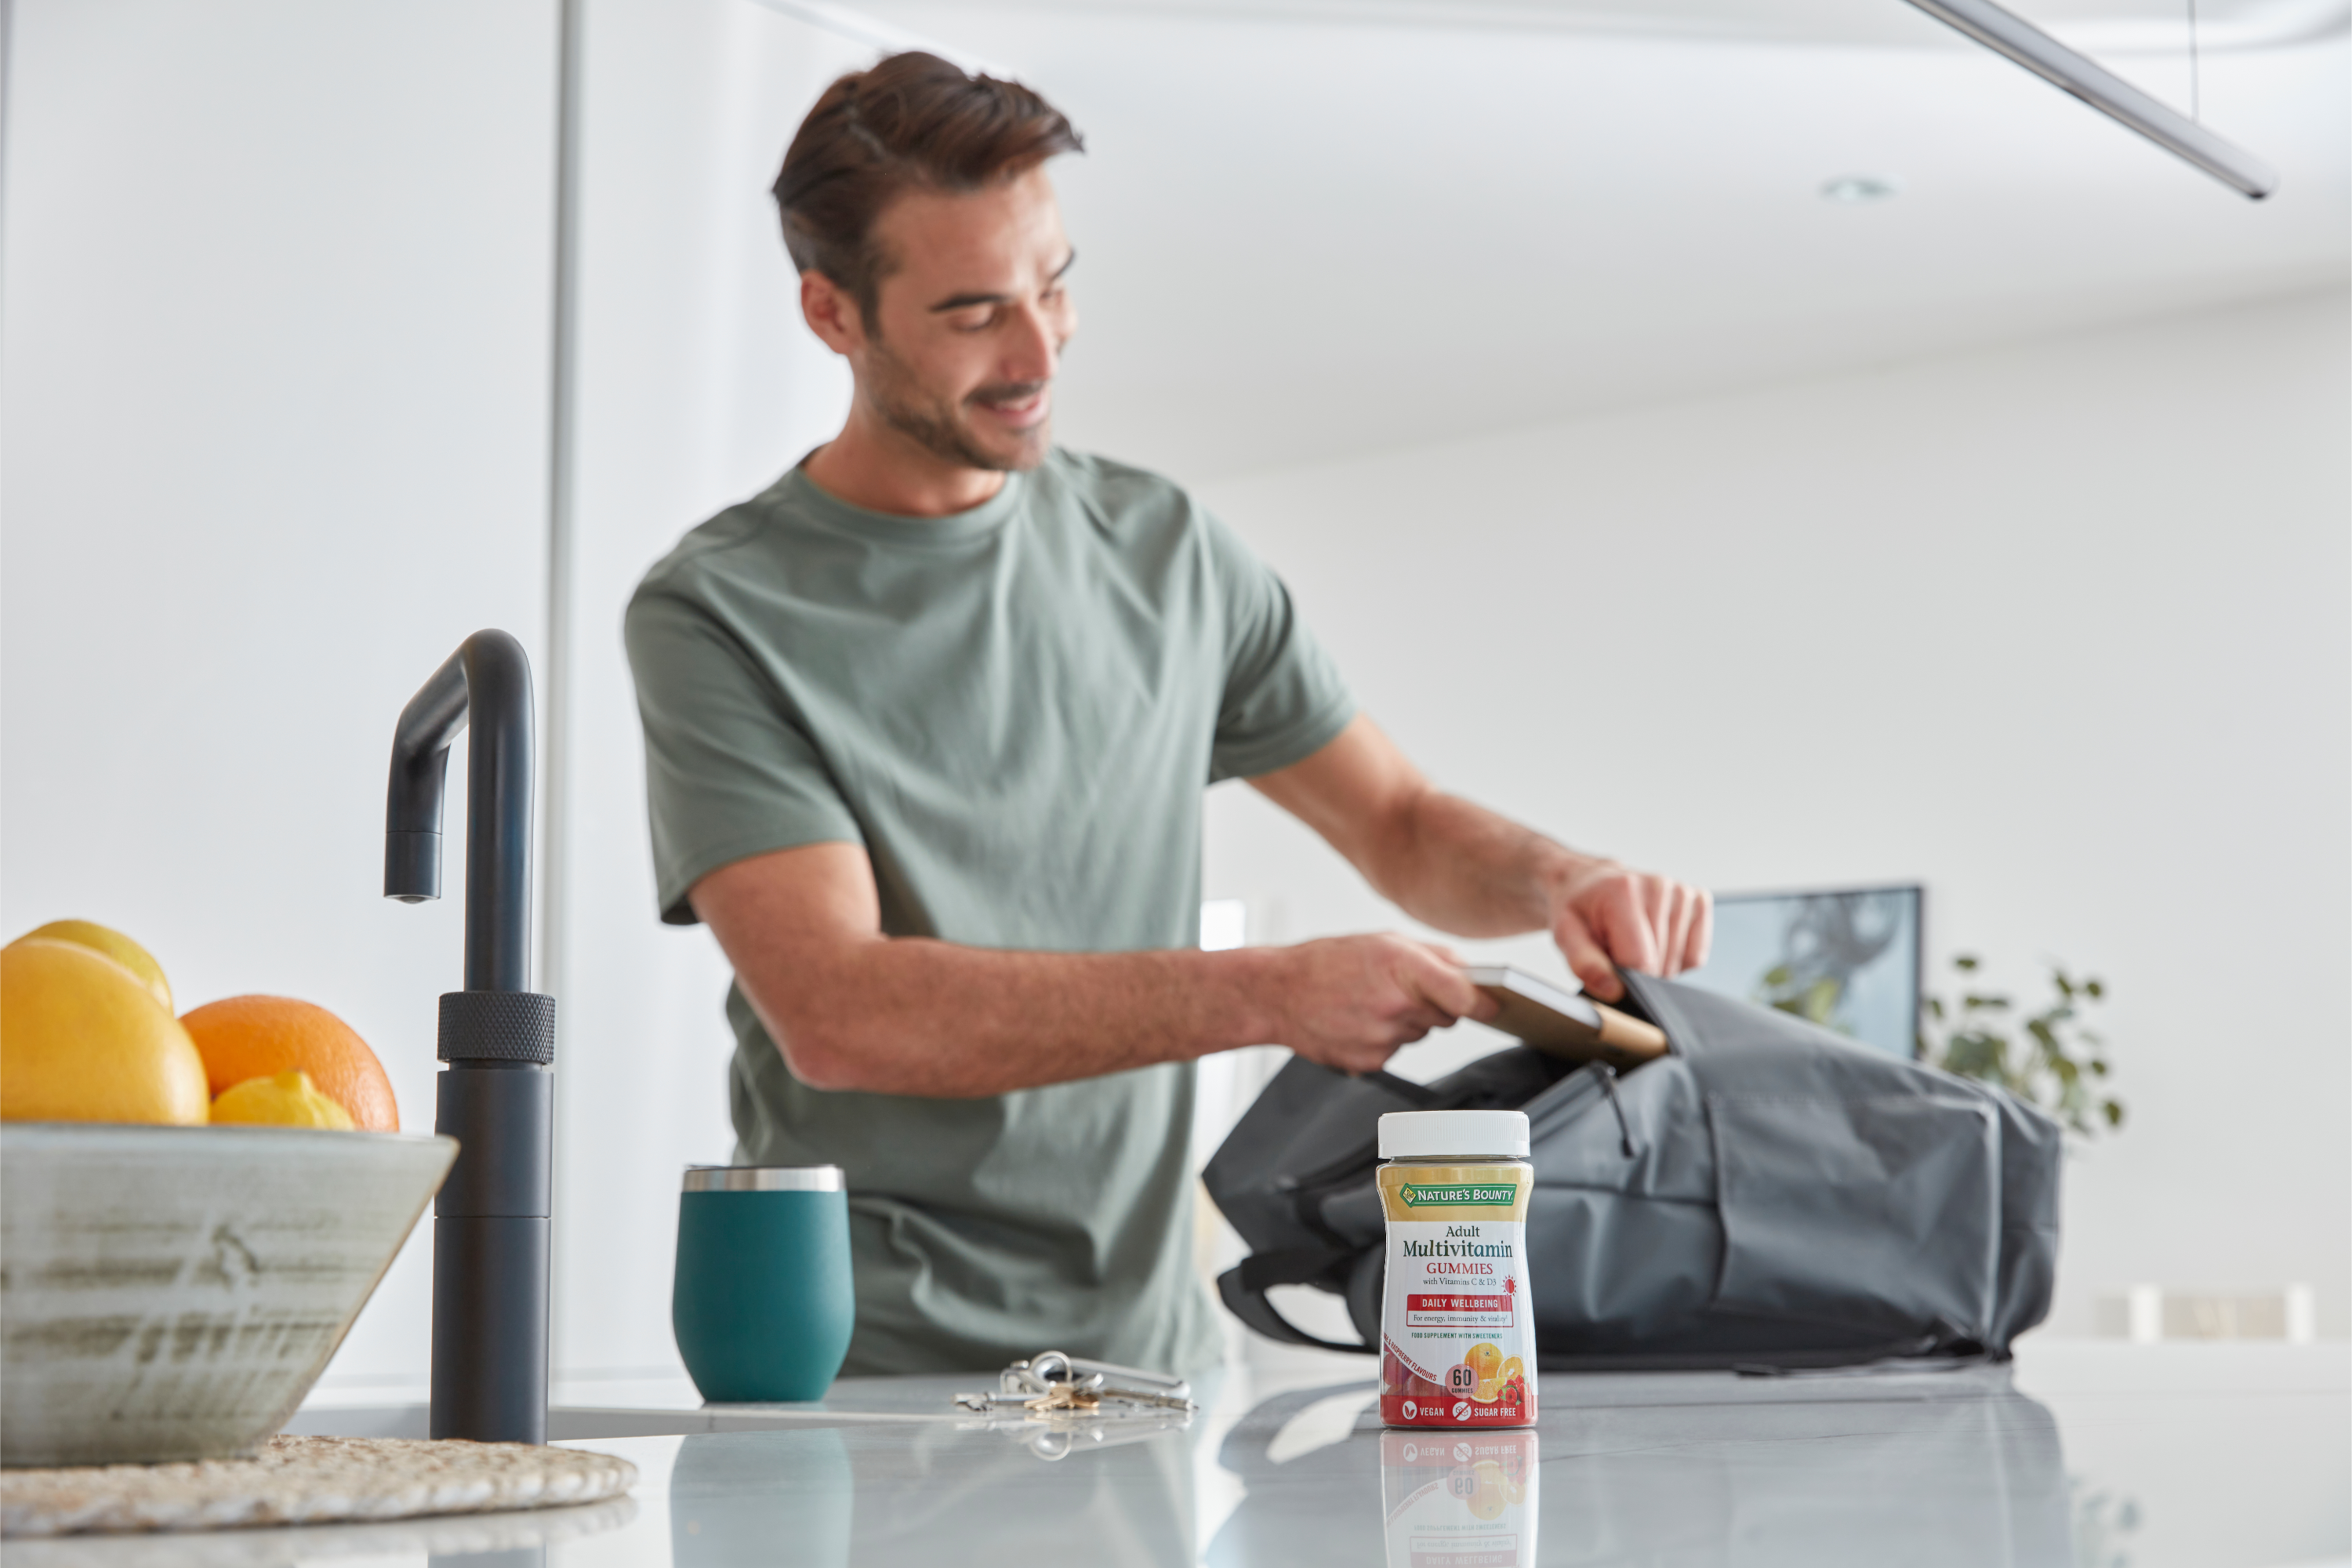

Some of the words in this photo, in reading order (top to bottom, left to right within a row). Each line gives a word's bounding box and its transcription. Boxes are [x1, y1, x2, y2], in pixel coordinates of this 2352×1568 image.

[1417, 1189, 1470, 1201] NATURE'S
[1473, 1189, 1514, 1200] BOUNTY
[1446, 1225, 1480, 1237] Adult
[1403, 1240, 1513, 1258] Multivitamin
[1426, 1262, 1494, 1275] GUMMIES
[1439, 1277, 1470, 1286] Vitamins
[1486, 1278, 1497, 1287] D3
[1422, 1298, 1447, 1308] DAILY
[1450, 1299, 1498, 1308] WELLBEING
[1447, 1315, 1479, 1323] immunity
[1391, 1341, 1413, 1366] RASPBERRY
[1411, 1362, 1438, 1381] FLAVOURS
[1453, 1369, 1472, 1386] 60
[1420, 1406, 1444, 1417] VEGAN
[1474, 1407, 1498, 1417] SUGAR
[1500, 1407, 1516, 1417] FREE
